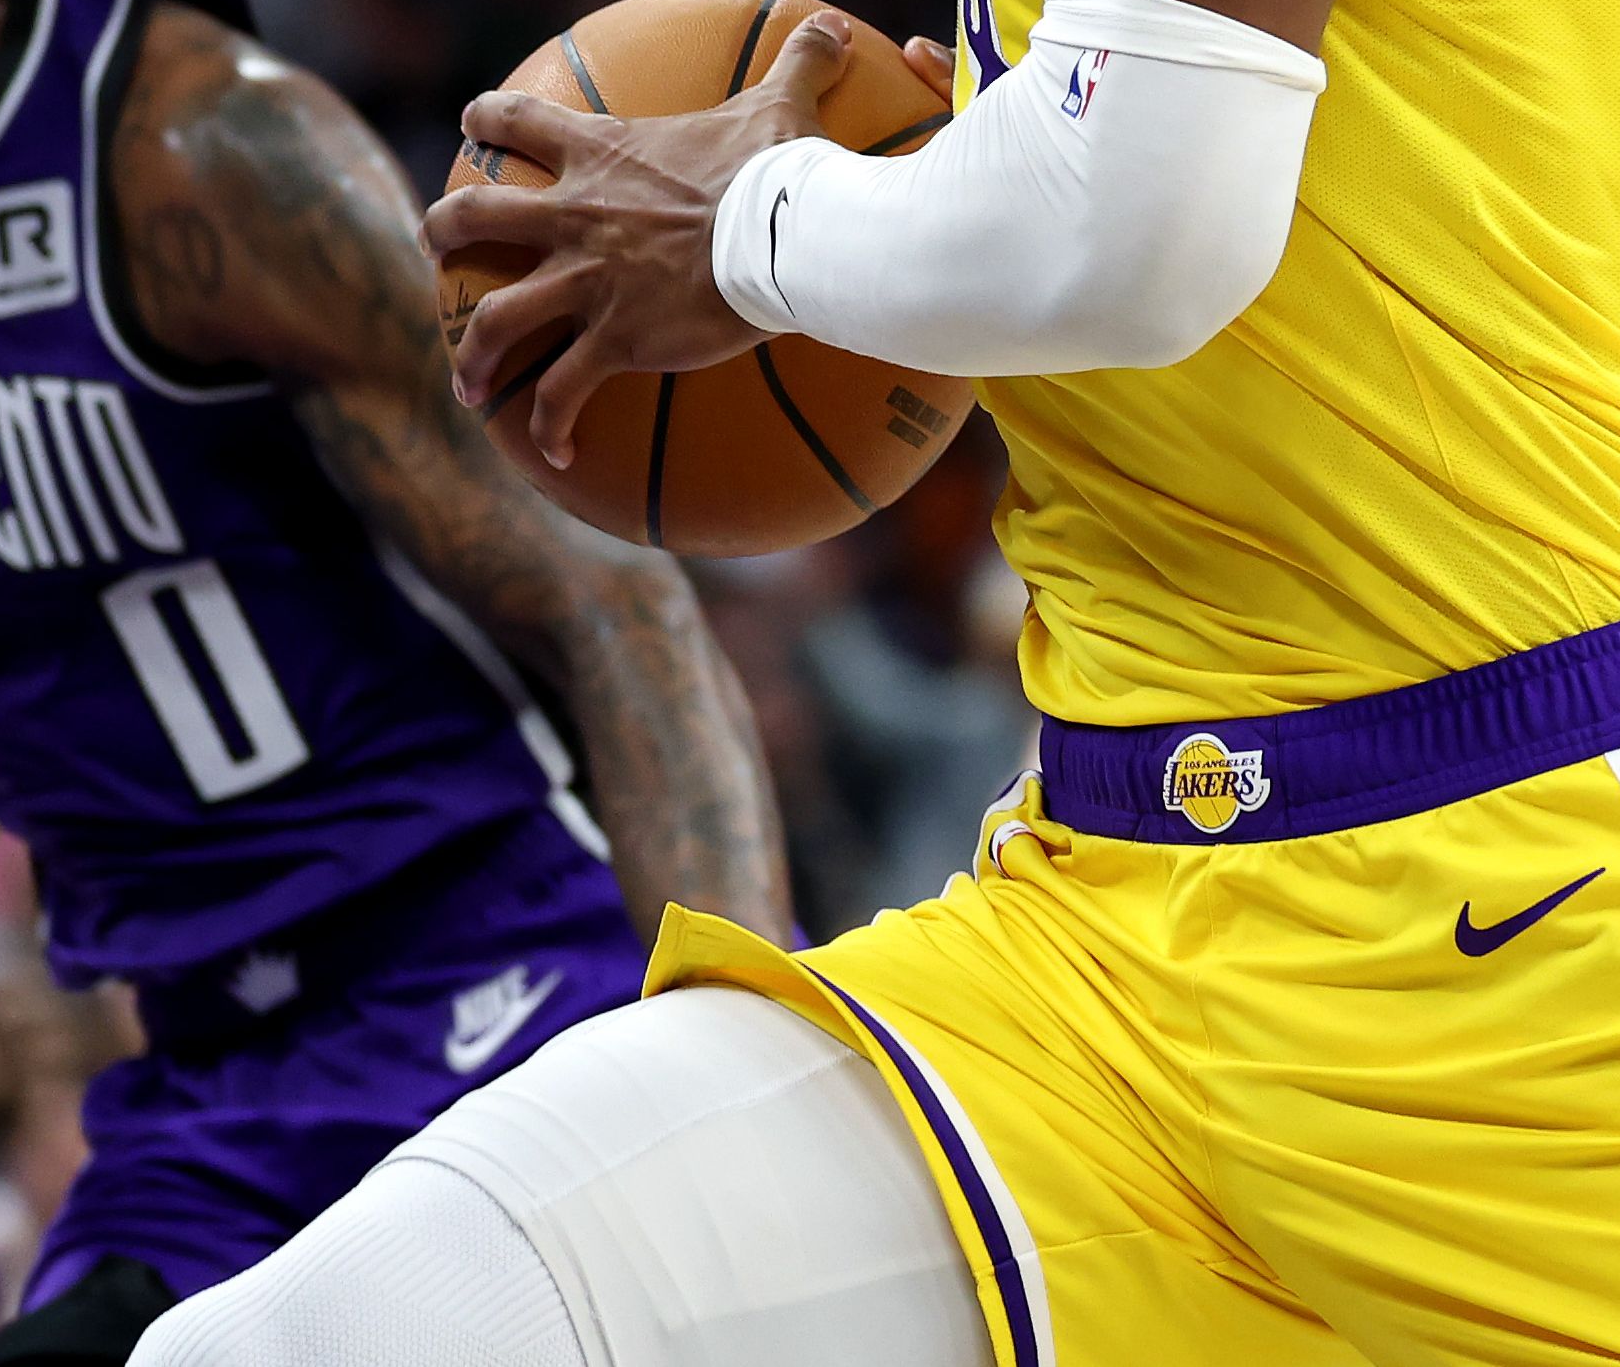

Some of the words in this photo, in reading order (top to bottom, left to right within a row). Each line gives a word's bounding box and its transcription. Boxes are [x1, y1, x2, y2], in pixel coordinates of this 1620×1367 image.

[100, 557, 311, 804] 0
[1166, 761, 1264, 807] LAKERS
[1184, 760, 1201, 770] LOS
[1202, 756, 1256, 769] ANGELES
